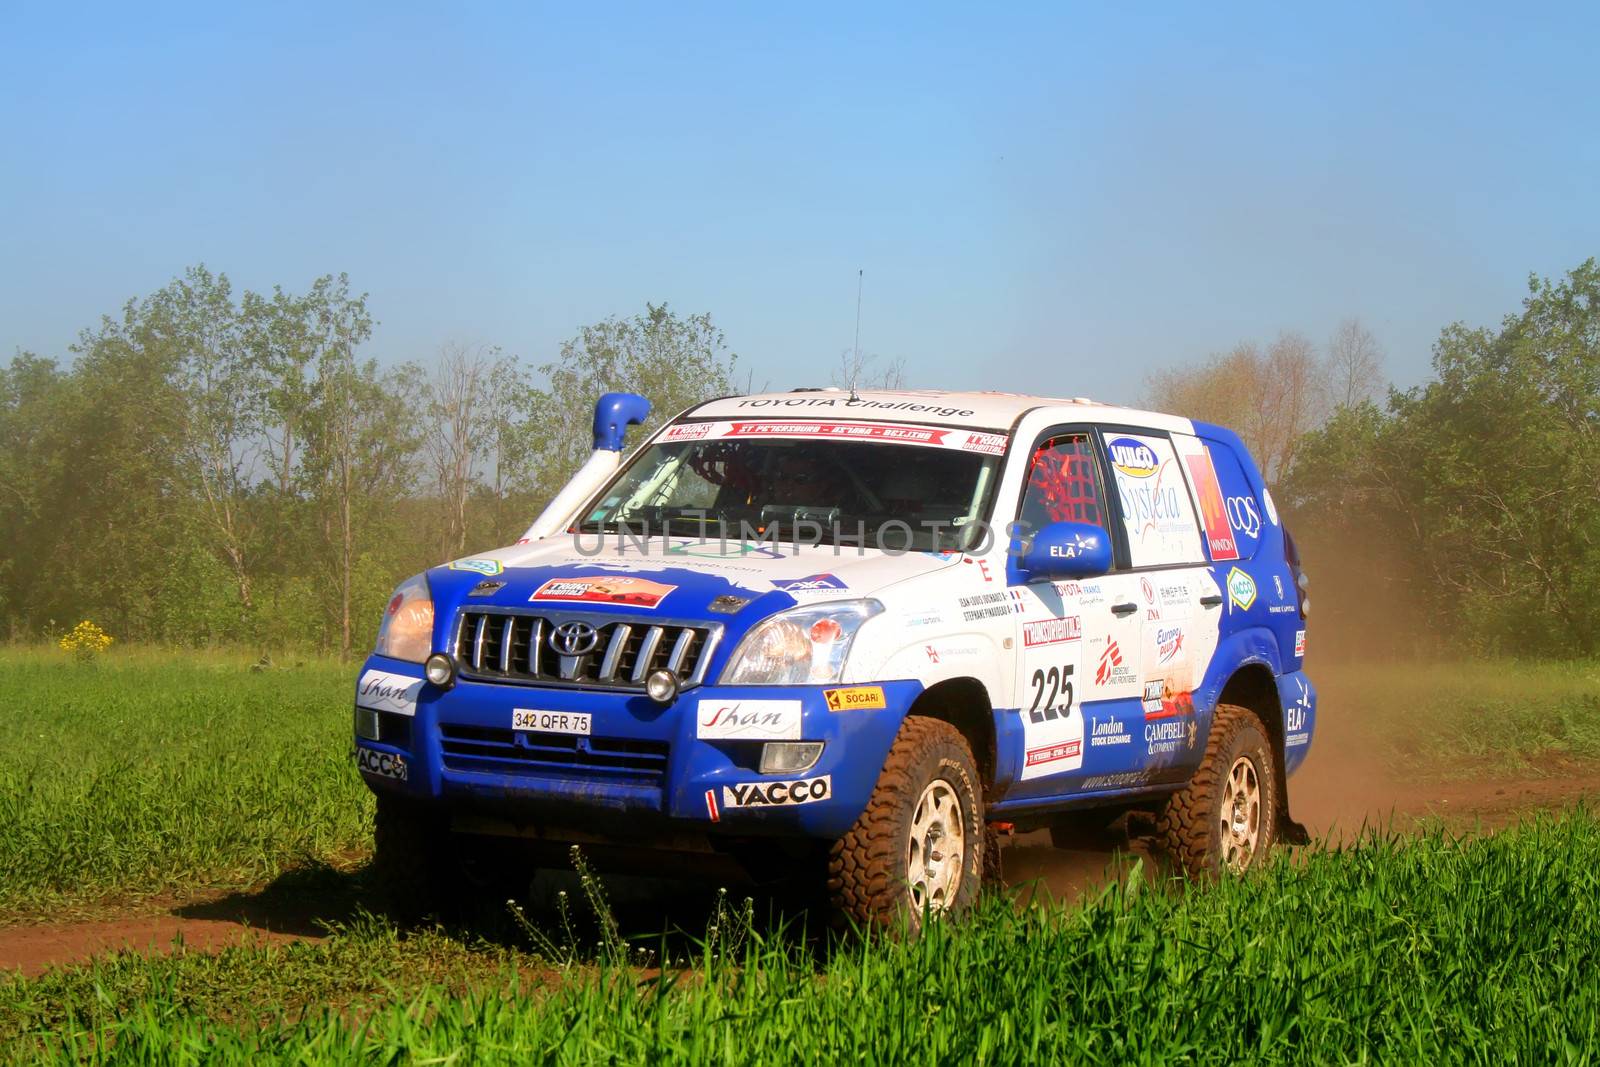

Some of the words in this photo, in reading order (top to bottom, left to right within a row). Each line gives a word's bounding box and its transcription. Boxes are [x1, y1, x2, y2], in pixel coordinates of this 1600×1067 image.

[737, 399, 835, 408] TOYOTA
[844, 400, 974, 417] Challenge
[1111, 446, 1154, 470] VULCO
[1227, 497, 1260, 538] CQS
[1050, 546, 1076, 558] ELA
[1051, 584, 1082, 597] TOYOTA
[1231, 581, 1253, 595] YACCO
[1147, 609, 1160, 621] ZNA
[361, 674, 406, 701] Shan
[1029, 664, 1074, 724] 225
[515, 713, 537, 728] 342
[541, 714, 569, 729] QFR
[573, 716, 588, 731] 75
[702, 703, 783, 727] Shan
[1287, 708, 1302, 732] ELA
[1092, 716, 1123, 736] London
[1145, 722, 1186, 742] CAMPBELL
[1091, 737, 1107, 746] STOCK
[1107, 734, 1131, 745] EXCHANGE
[732, 778, 828, 806] YACCO
